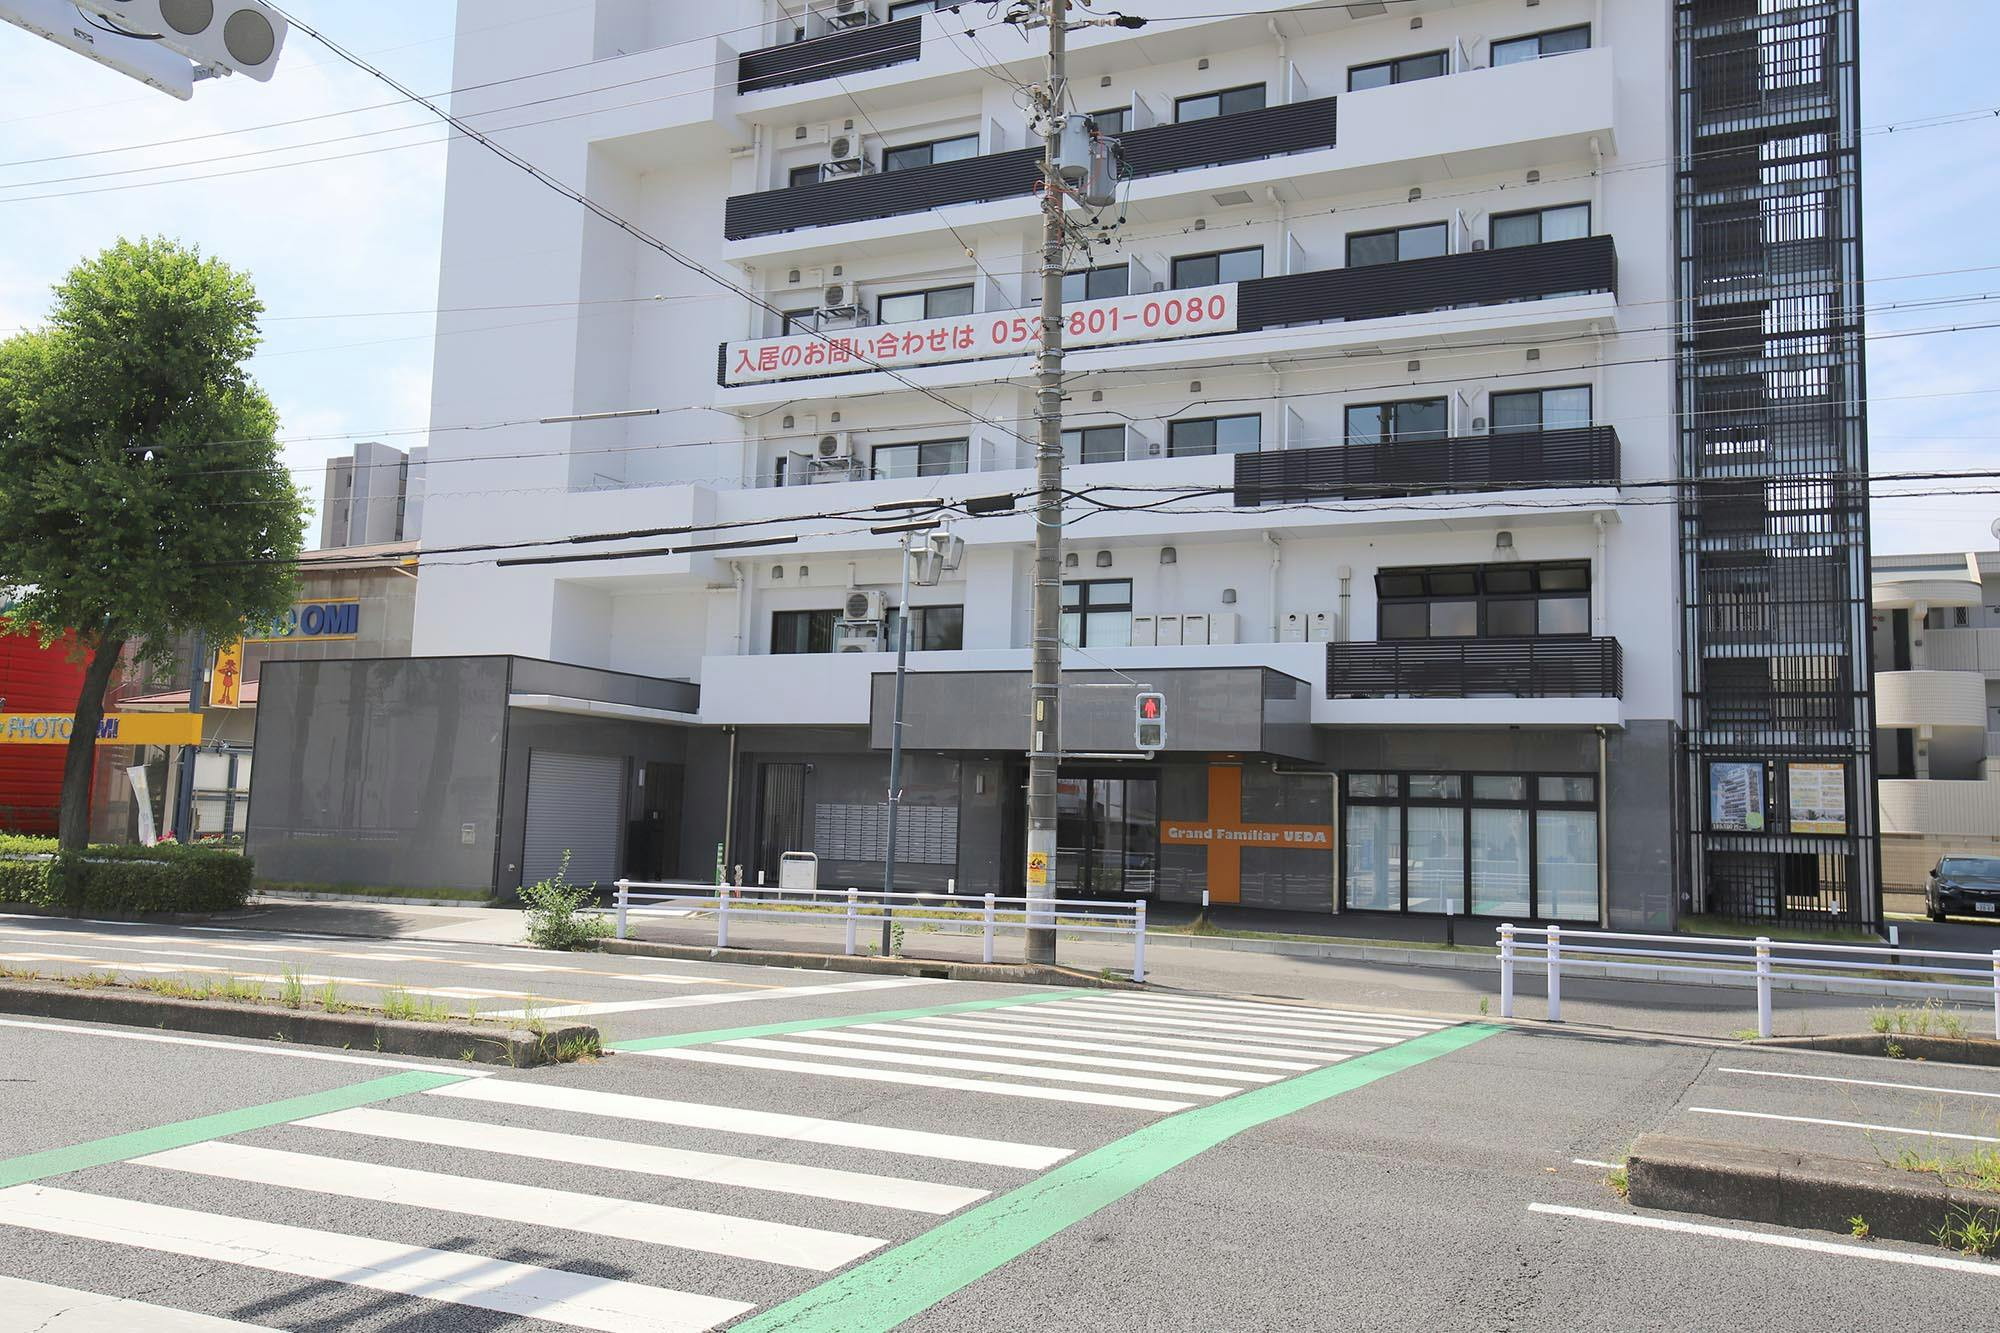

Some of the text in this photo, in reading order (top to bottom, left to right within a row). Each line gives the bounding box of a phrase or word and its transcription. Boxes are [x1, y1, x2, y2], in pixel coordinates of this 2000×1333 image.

[734, 294, 1226, 374] 入居のお問い合わせは 052801-0080
[300, 604, 360, 635] OMI
[8, 717, 120, 739] PHOTO MI
[1168, 827, 1327, 843] Grand Familiar UEDA
